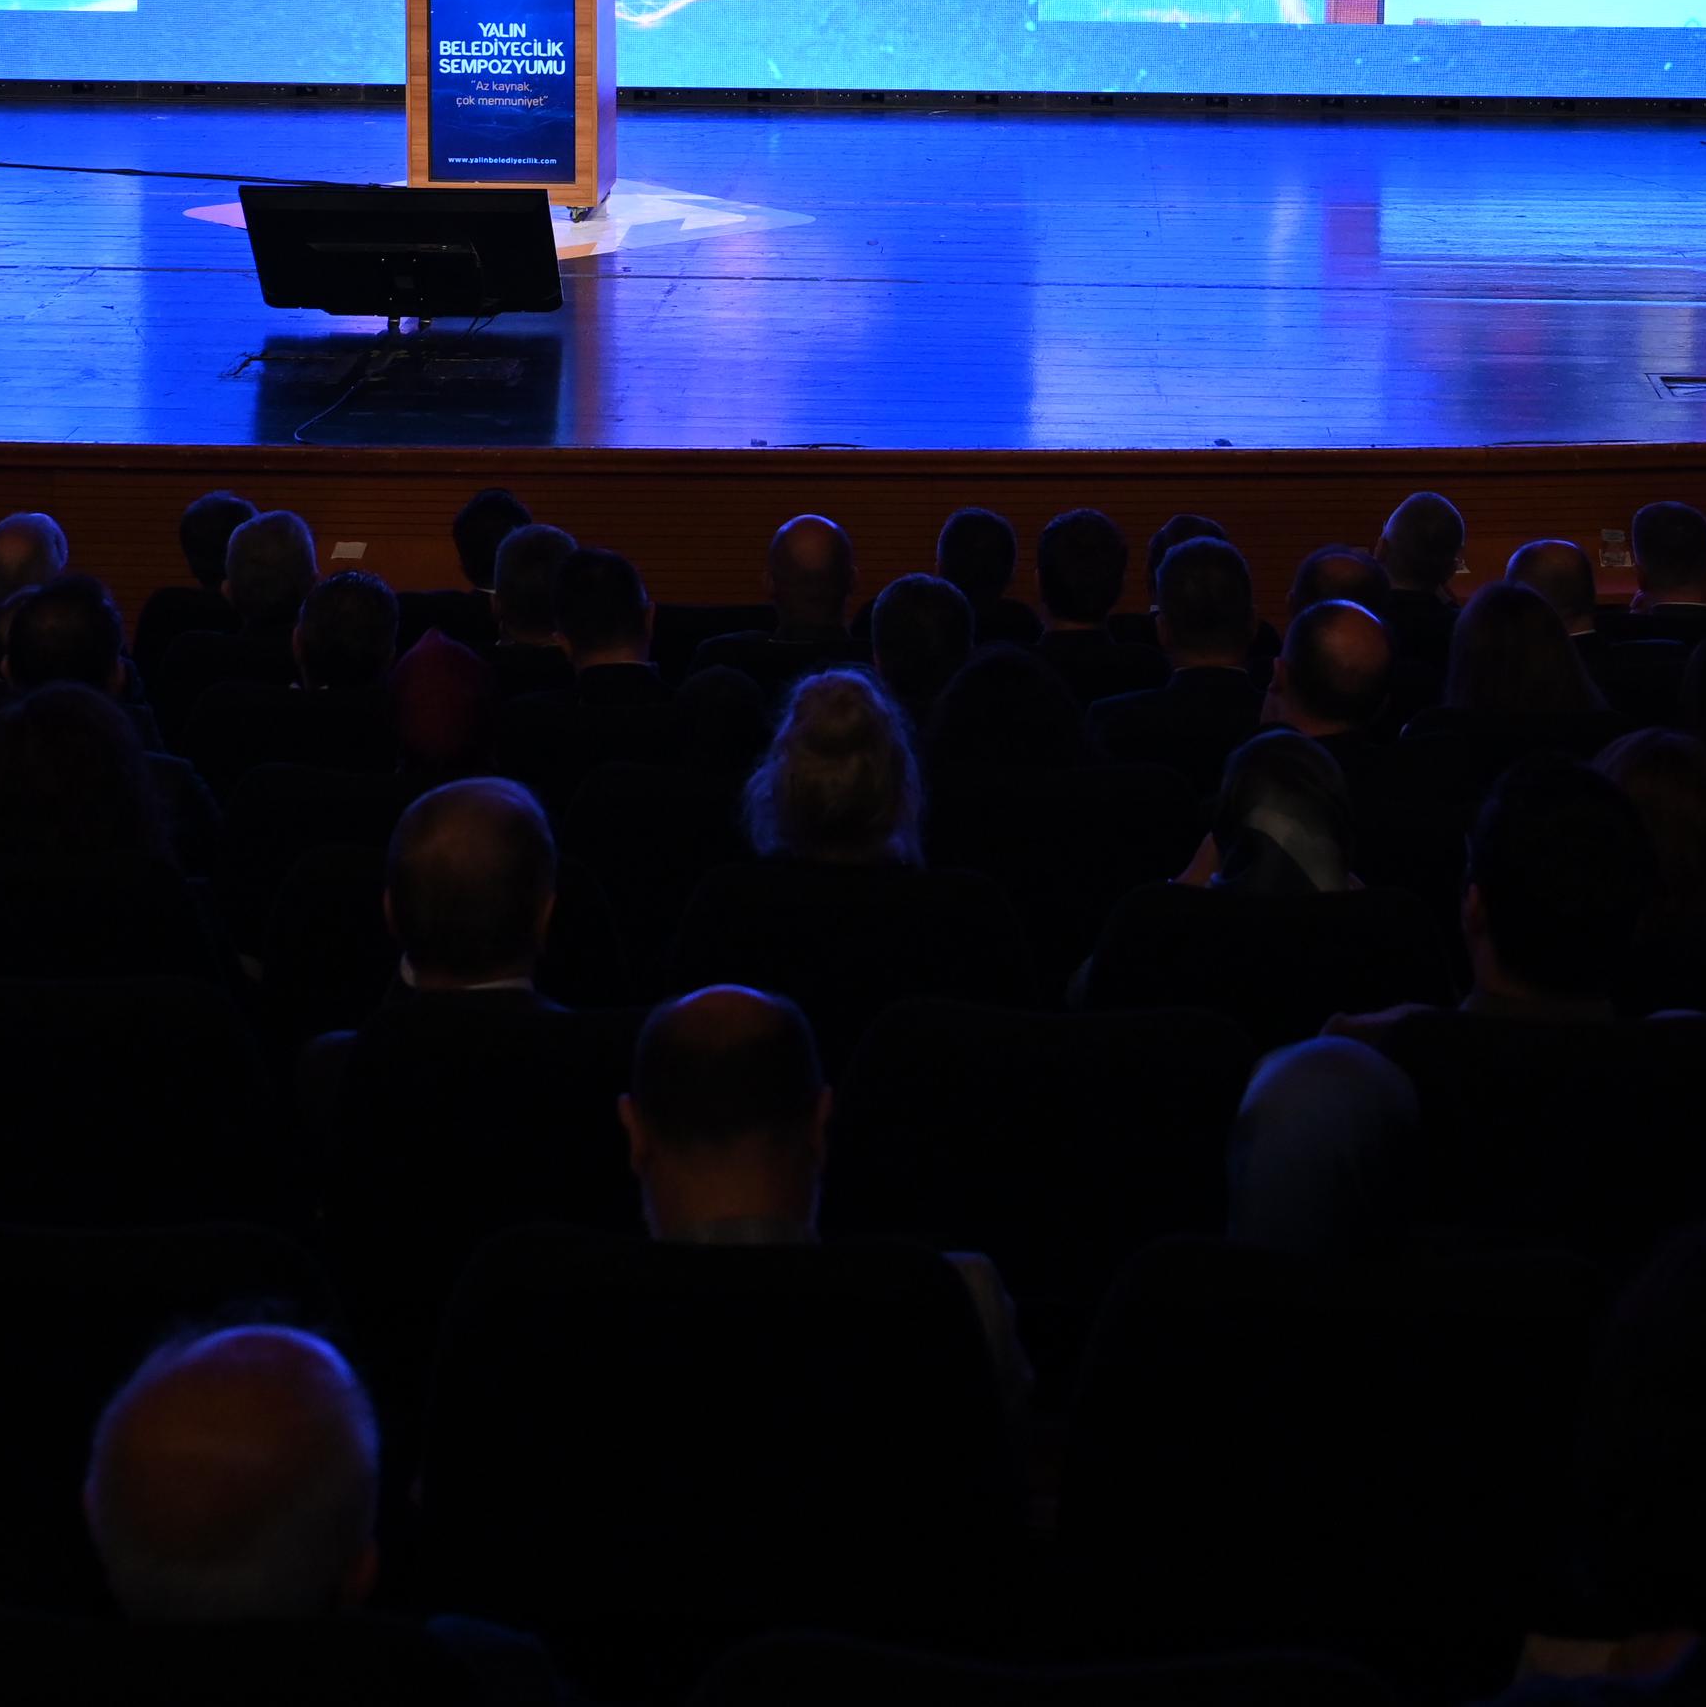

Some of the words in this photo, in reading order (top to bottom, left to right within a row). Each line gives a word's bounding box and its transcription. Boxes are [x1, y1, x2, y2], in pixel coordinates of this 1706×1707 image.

[478, 22, 526, 38] YALIN
[439, 38, 564, 57] BELEDİYECİLİK
[439, 58, 566, 75] SEMPOZYUMU
